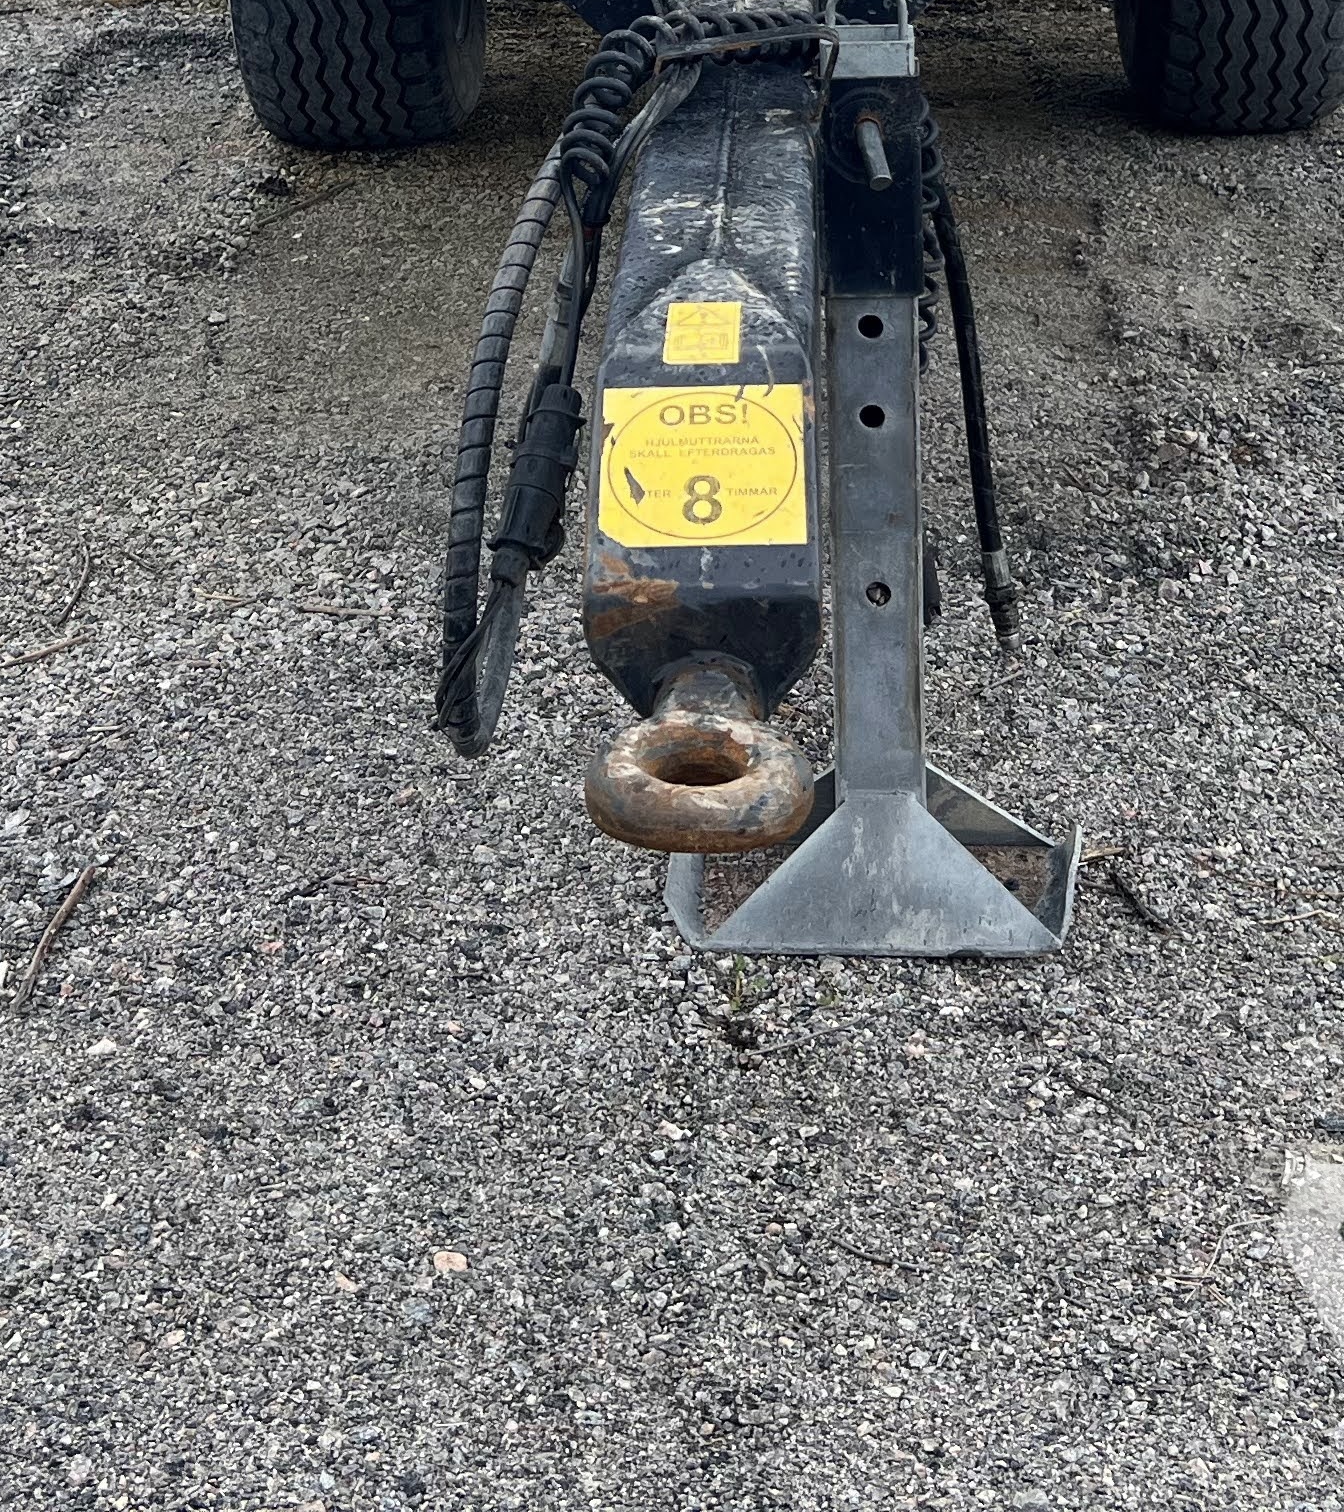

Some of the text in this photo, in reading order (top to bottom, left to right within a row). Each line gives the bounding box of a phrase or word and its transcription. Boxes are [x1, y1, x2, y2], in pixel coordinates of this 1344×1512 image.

[659, 403, 748, 426] OBS!
[645, 436, 760, 447] HJULMUTTRARNA
[629, 446, 776, 459] SKALL EFTERDRAGAS
[682, 474, 723, 525] 8
[726, 486, 778, 497] TIMMAR
